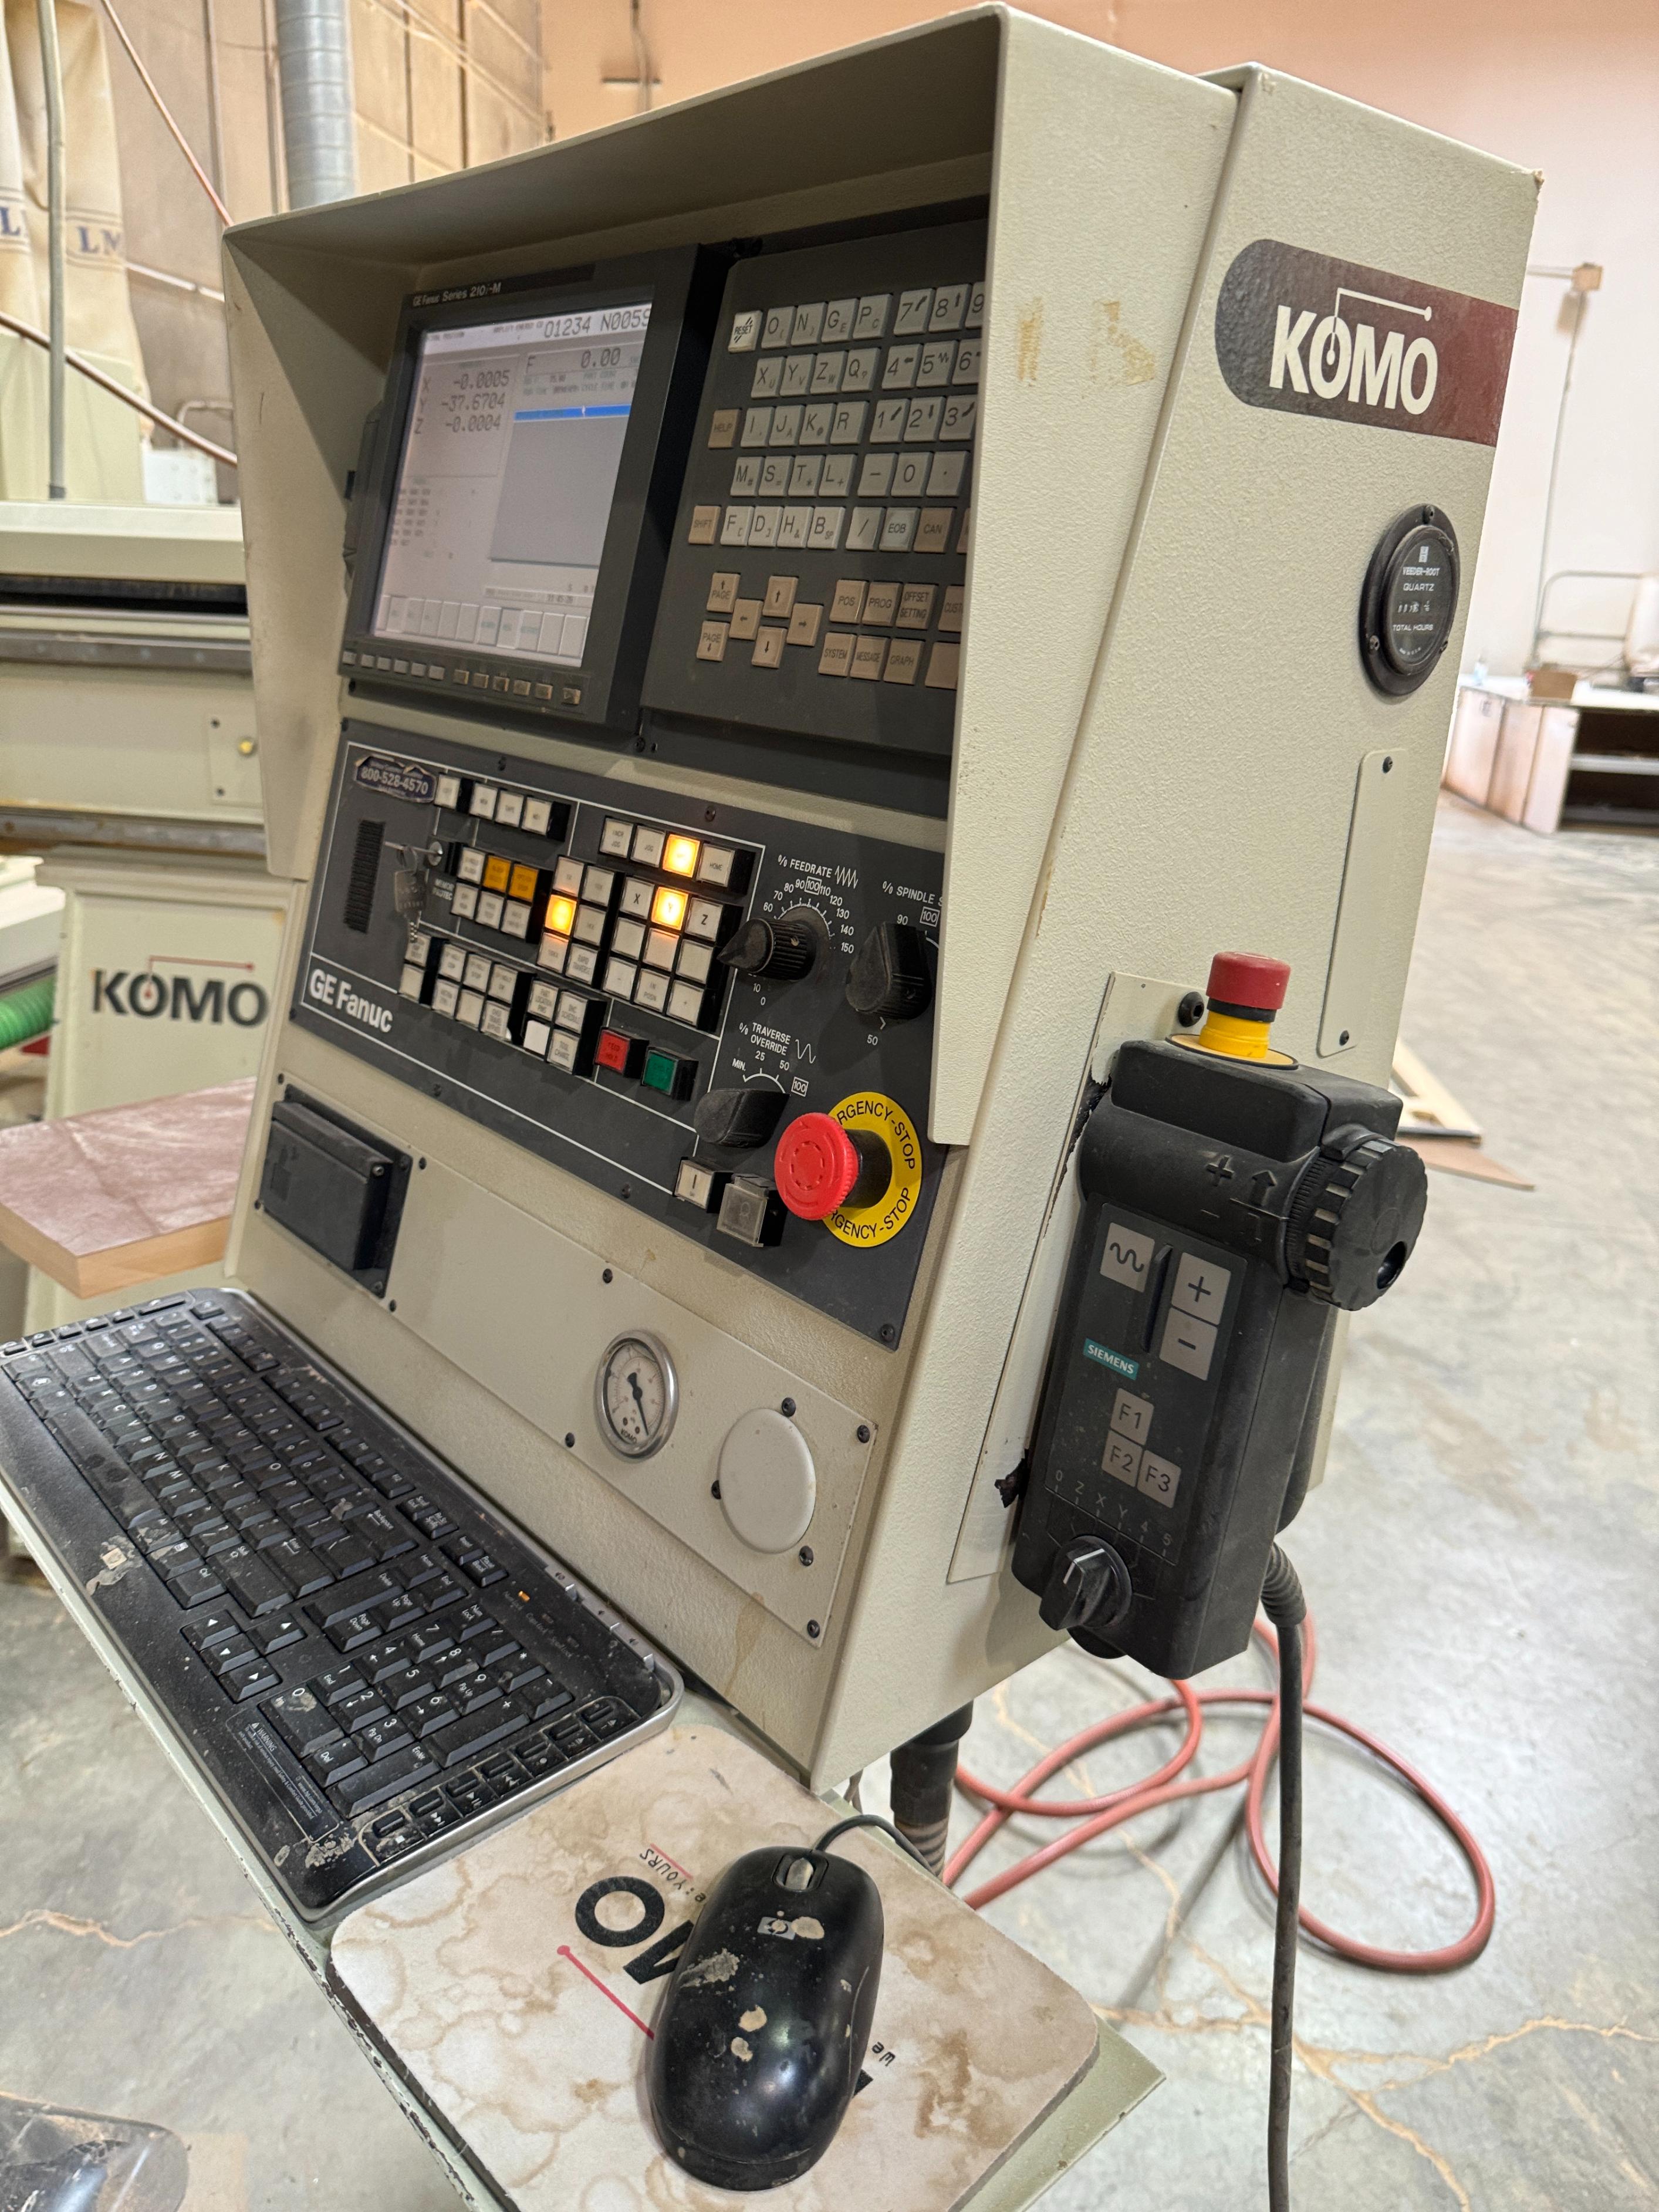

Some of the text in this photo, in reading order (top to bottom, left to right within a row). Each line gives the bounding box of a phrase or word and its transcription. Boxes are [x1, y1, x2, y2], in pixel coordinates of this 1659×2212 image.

[442, 289, 468, 302] Series
[935, 299, 947, 318] 8
[972, 294, 984, 313] 9
[859, 306, 871, 325] P
[900, 303, 911, 320] 7
[796, 314, 808, 331] N
[827, 310, 839, 328] G
[734, 323, 753, 336] RESET
[580, 347, 621, 369] 0.00
[921, 355, 934, 374] 5
[958, 353, 971, 370] 6
[1269, 305, 1438, 415] KOMO
[788, 364, 799, 381] Y
[816, 362, 829, 380] Z
[848, 360, 860, 378] Q
[888, 358, 898, 376] 4
[454, 370, 511, 390] -0.0005
[756, 367, 768, 384] X
[441, 392, 505, 412] -37.6704
[414, 414, 502, 434] Z -0.0004
[806, 413, 816, 431] K
[837, 412, 849, 430] R
[877, 413, 884, 429] 1
[908, 410, 923, 428] 2
[944, 408, 958, 426] 3
[776, 417, 786, 432] J
[736, 465, 748, 481] M
[765, 465, 775, 482] S
[796, 465, 807, 482] T
[825, 465, 836, 482] L
[694, 518, 713, 529] SHIFT
[727, 515, 736, 531] F
[754, 516, 766, 532] D
[783, 516, 795, 533] H
[814, 517, 826, 533] B
[888, 523, 906, 534] EOB
[924, 524, 943, 534] CAN
[1402, 566, 1440, 576] VEEDER-ROOT
[711, 589, 730, 600] PAGE
[1403, 583, 1435, 592] QUARTZ
[838, 596, 855, 607] POS
[869, 597, 892, 609] PROG
[904, 591, 929, 603] OFFSET
[900, 607, 927, 620] SETTING
[944, 602, 962, 613] CUST
[702, 632, 721, 643] PAGE
[823, 648, 847, 659] SYSTEM
[856, 651, 880, 663] MESSAGE
[890, 655, 914, 666] GRAPH
[360, 765, 429, 795] 800-528-4570
[644, 844, 654, 852] JOG
[709, 863, 723, 871] HOME
[778, 855, 833, 879] % FEEDRATE
[435, 878, 454, 890] MEMOR
[784, 883, 795, 893] 80
[795, 880, 805, 889] 90
[806, 880, 820, 891] 100
[820, 885, 831, 897] 110
[431, 887, 453, 901] PROTEC
[633, 893, 641, 904] X
[773, 890, 783, 901] 70
[882, 880, 893, 894] %
[896, 886, 935, 904] SPINDLE
[830, 894, 843, 906] 120
[763, 903, 773, 912] 60
[836, 908, 850, 920] 130
[701, 914, 708, 926] Z
[897, 914, 908, 926] 90
[923, 910, 937, 923] 100
[840, 924, 854, 936] 140
[841, 942, 854, 953] 150
[753, 983, 761, 992] 10
[92, 967, 269, 1028] KOMO
[310, 968, 393, 1033] GE Fanuc
[739, 1022, 791, 1045] % TRAVERSE
[867, 1034, 879, 1046] 50
[751, 1034, 788, 1056] OVERRIDE
[755, 1050, 766, 1061] 25
[779, 1059, 789, 1070] 50
[793, 1080, 806, 1092] 100
[836, 1100, 915, 1169] RGENCY-STOP
[1087, 1344, 1134, 1375] SIEMENS
[1119, 1402, 1143, 1430] F1
[620, 1428, 637, 1444] KOMO
[1110, 1445, 1133, 1473] F2
[1145, 1465, 1171, 1492] F3
[1075, 1480, 1084, 1494] Z
[1096, 1492, 1106, 1507] X
[1119, 1504, 1128, 1518] Y
[441, 1575, 454, 1585] End
[392, 1599, 401, 1607] Up
[401, 1594, 413, 1606] Page
[350, 1617, 363, 1631] Down
[425, 1624, 440, 1632] 7
[412, 1633, 425, 1646] Home
[449, 1648, 462, 1657] 8
[323, 1674, 336, 1685] End
[406, 1669, 420, 1678] 5
[474, 1674, 486, 1683] 9
[360, 1691, 374, 1701] 2
[430, 1696, 442, 1704] 6
[384, 1718, 397, 1728] 3
[258, 1728, 277, 1752] WARNING
[320, 1751, 333, 1762] Del
[412, 1745, 425, 1760] Enter
[639, 1848, 707, 1903] e:YOURS
